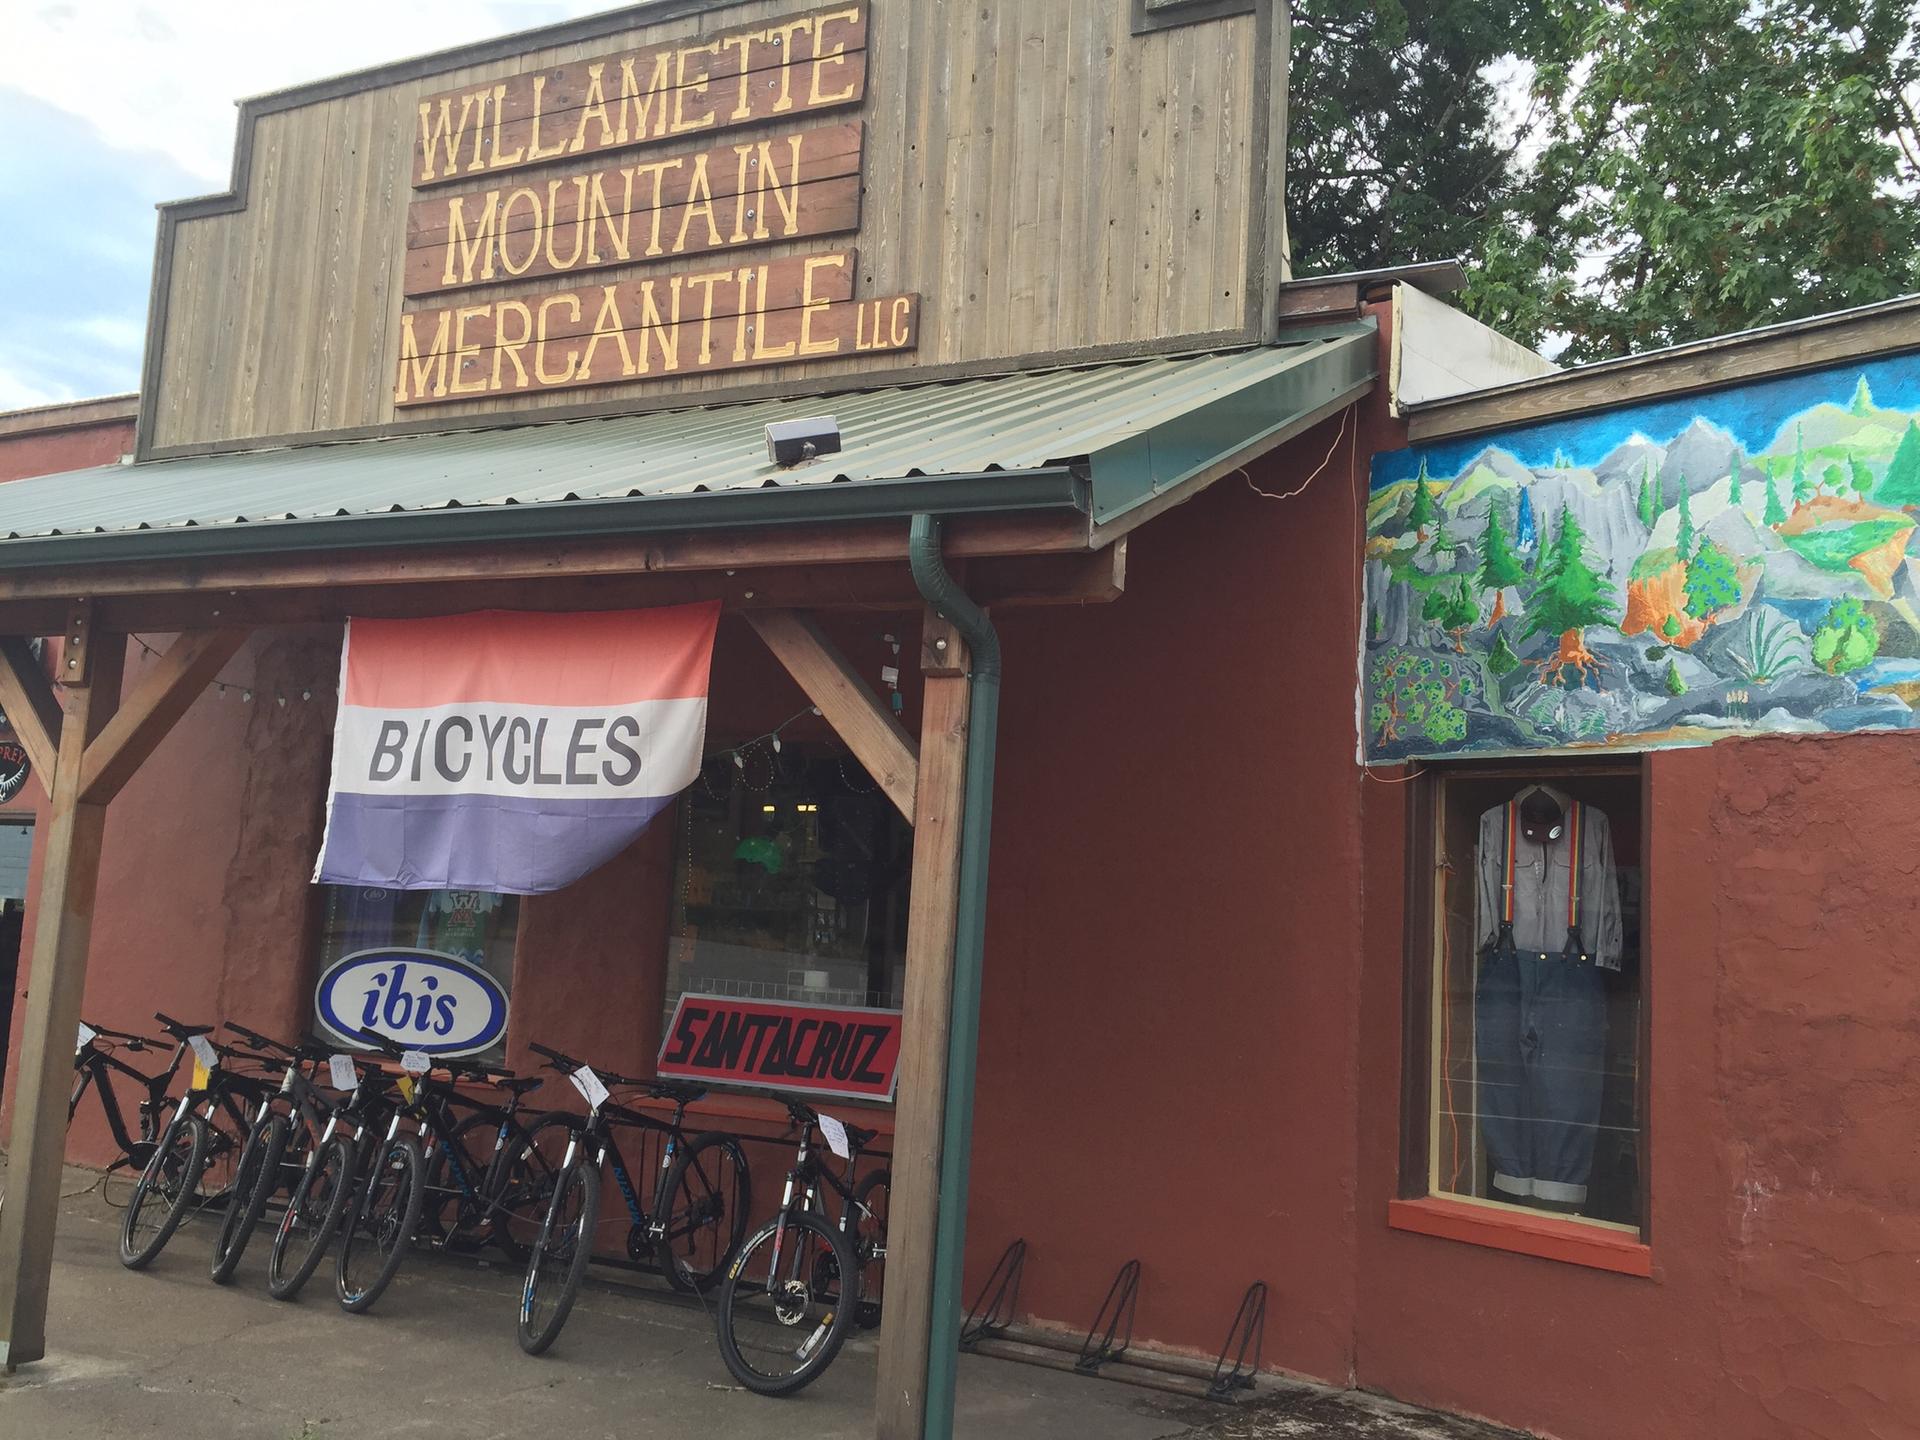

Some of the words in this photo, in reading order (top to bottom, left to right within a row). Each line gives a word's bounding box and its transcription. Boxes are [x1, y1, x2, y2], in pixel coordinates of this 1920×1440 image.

[418, 7, 860, 180] WILLAMETTE
[442, 134, 803, 285] MOUNTAIN
[395, 255, 848, 401] MERCANTILE
[855, 297, 911, 351] LLC
[368, 714, 642, 787] BICYCLES
[362, 963, 457, 1036] ibis
